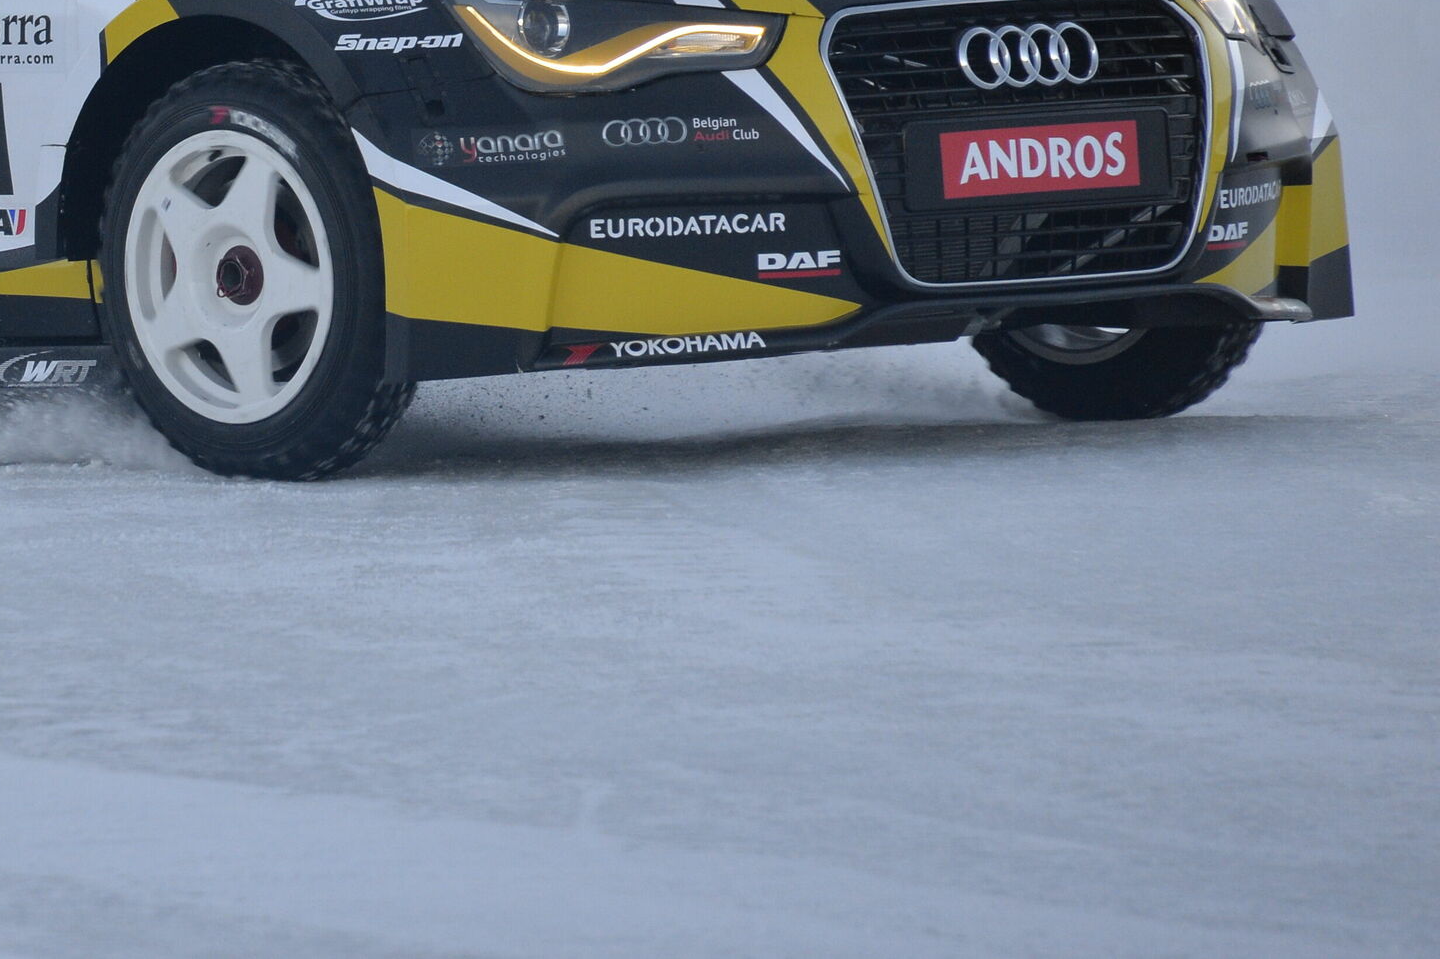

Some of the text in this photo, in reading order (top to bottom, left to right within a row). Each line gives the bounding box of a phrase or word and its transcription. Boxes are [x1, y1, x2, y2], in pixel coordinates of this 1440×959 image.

[334, 33, 463, 54] Snap-on
[692, 117, 737, 130] Belgian
[693, 128, 760, 142] Audi Club
[478, 149, 566, 164] technologies
[959, 131, 1126, 185] ANDROS
[590, 213, 785, 239] EURODATACAR
[1208, 222, 1248, 242] DAF
[758, 250, 841, 271] DAF
[610, 331, 766, 358] YOKOHAMA
[20, 359, 97, 383] WRT
